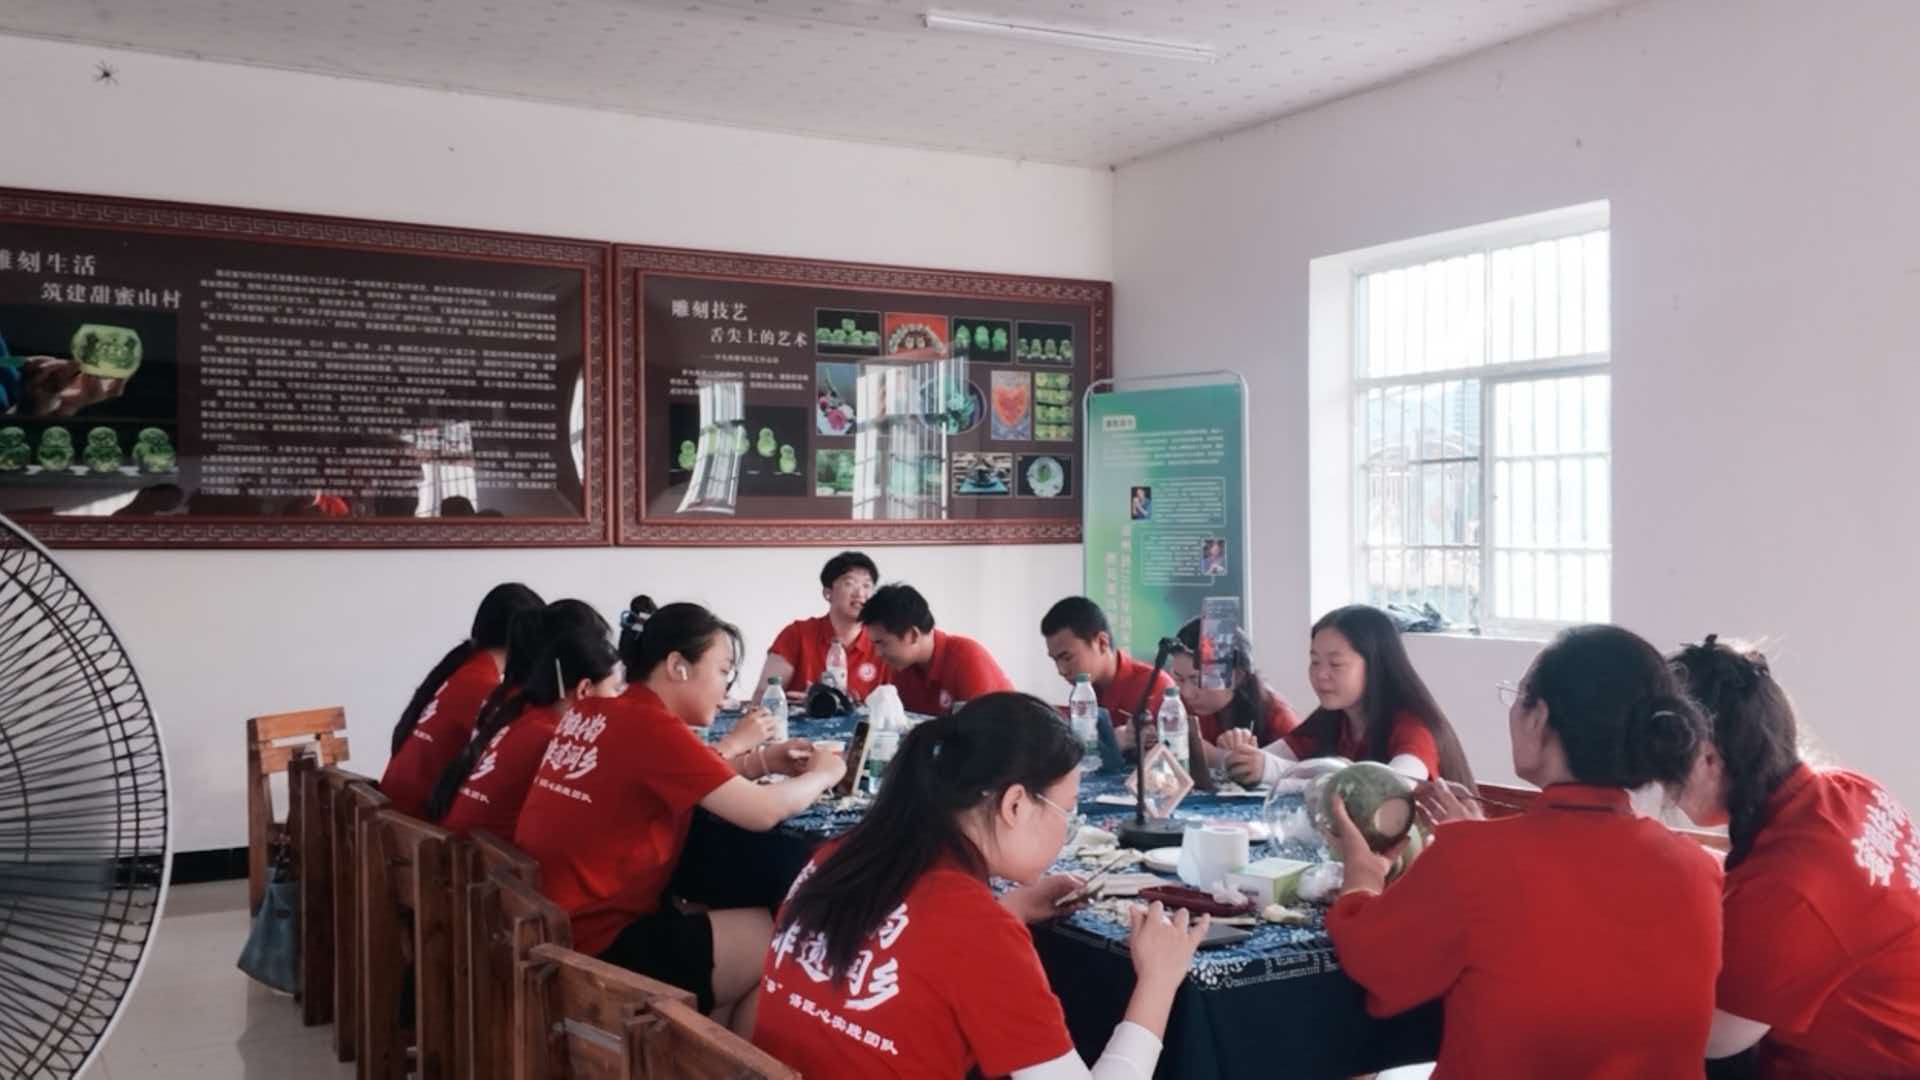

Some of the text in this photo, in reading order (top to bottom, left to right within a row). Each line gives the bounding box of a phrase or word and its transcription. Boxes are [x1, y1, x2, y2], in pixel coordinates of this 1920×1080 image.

[41, 282, 182, 309] 筑建甜蜜山村
[671, 299, 748, 322] 雕刻技艺
[710, 327, 808, 348] 舌尖上的艺术
